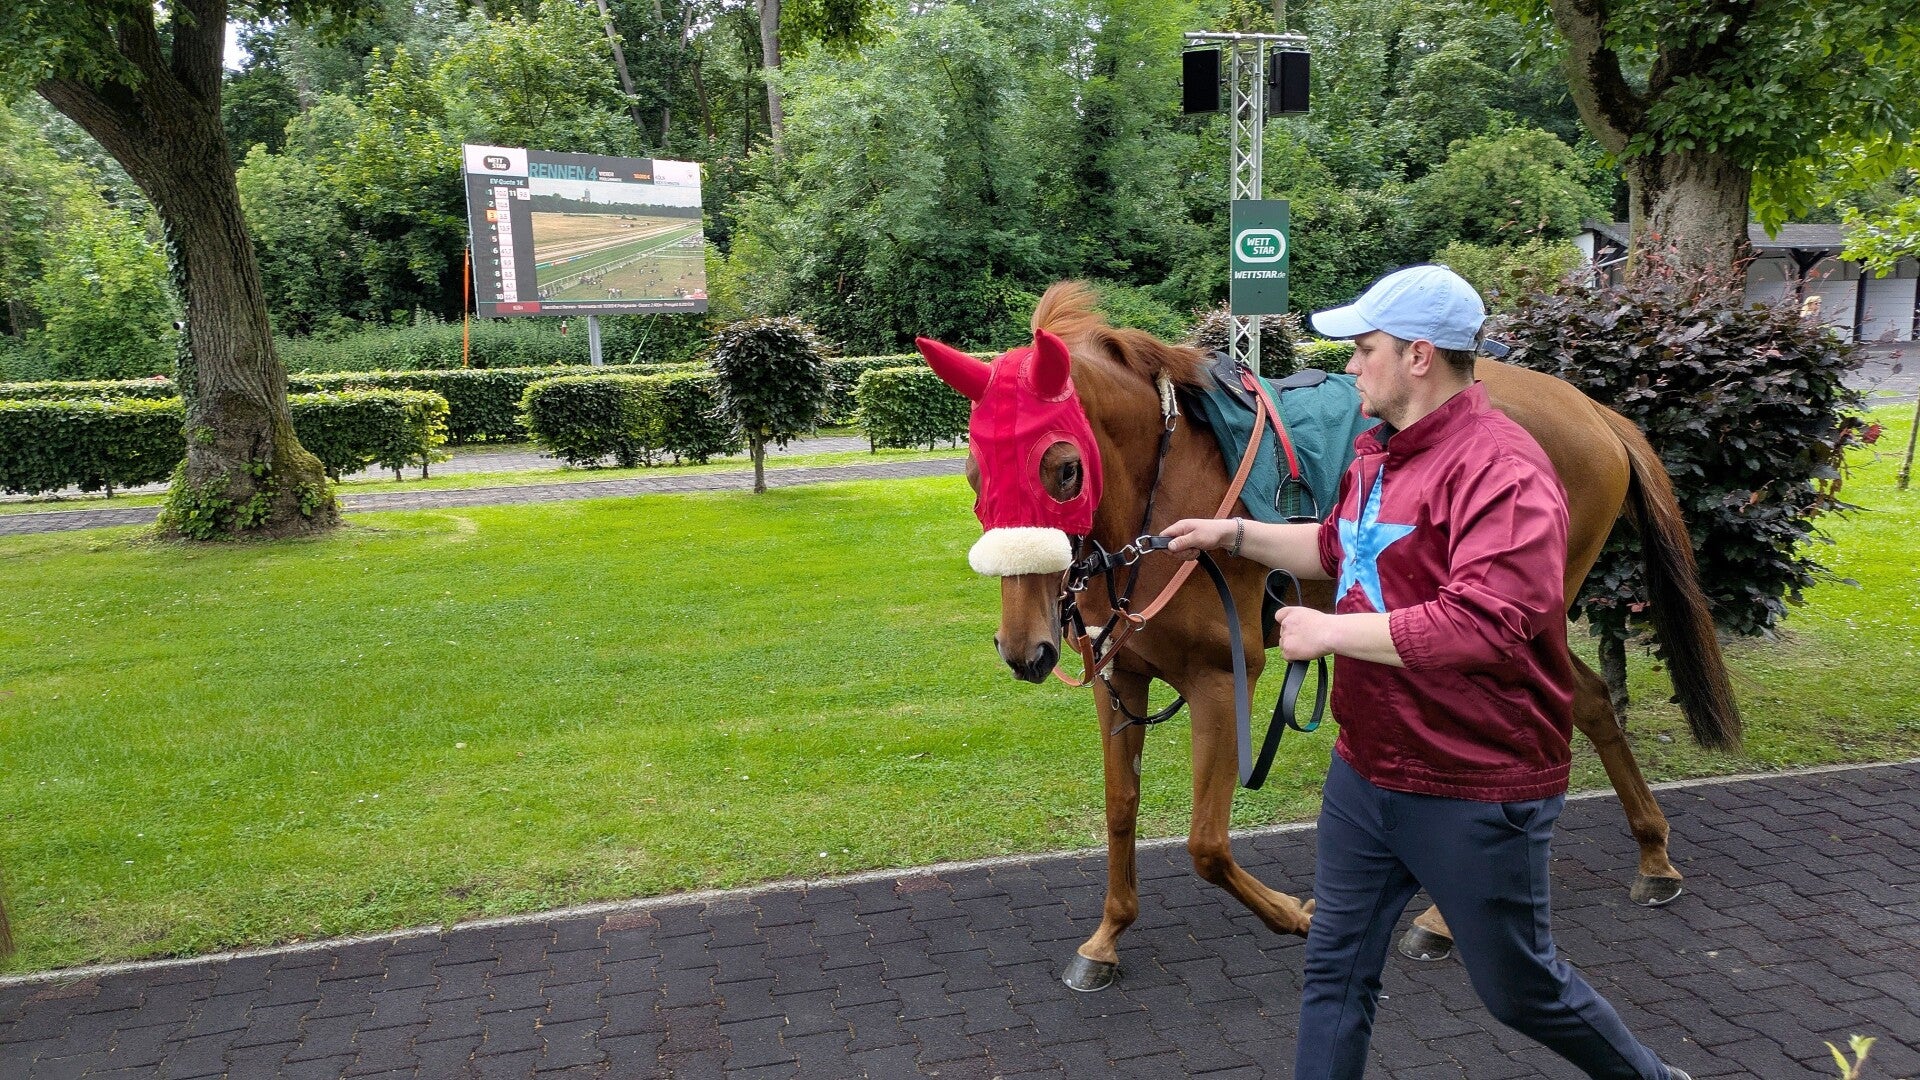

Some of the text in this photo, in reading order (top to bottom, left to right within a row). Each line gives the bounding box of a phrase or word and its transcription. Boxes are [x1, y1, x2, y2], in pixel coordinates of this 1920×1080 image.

[529, 163, 598, 181] RENNEN 4
[491, 235, 498, 243] 5
[1246, 237, 1271, 246] WETT
[1253, 246, 1275, 255] STAR
[1234, 270, 1286, 279] WETTSTAR.de
